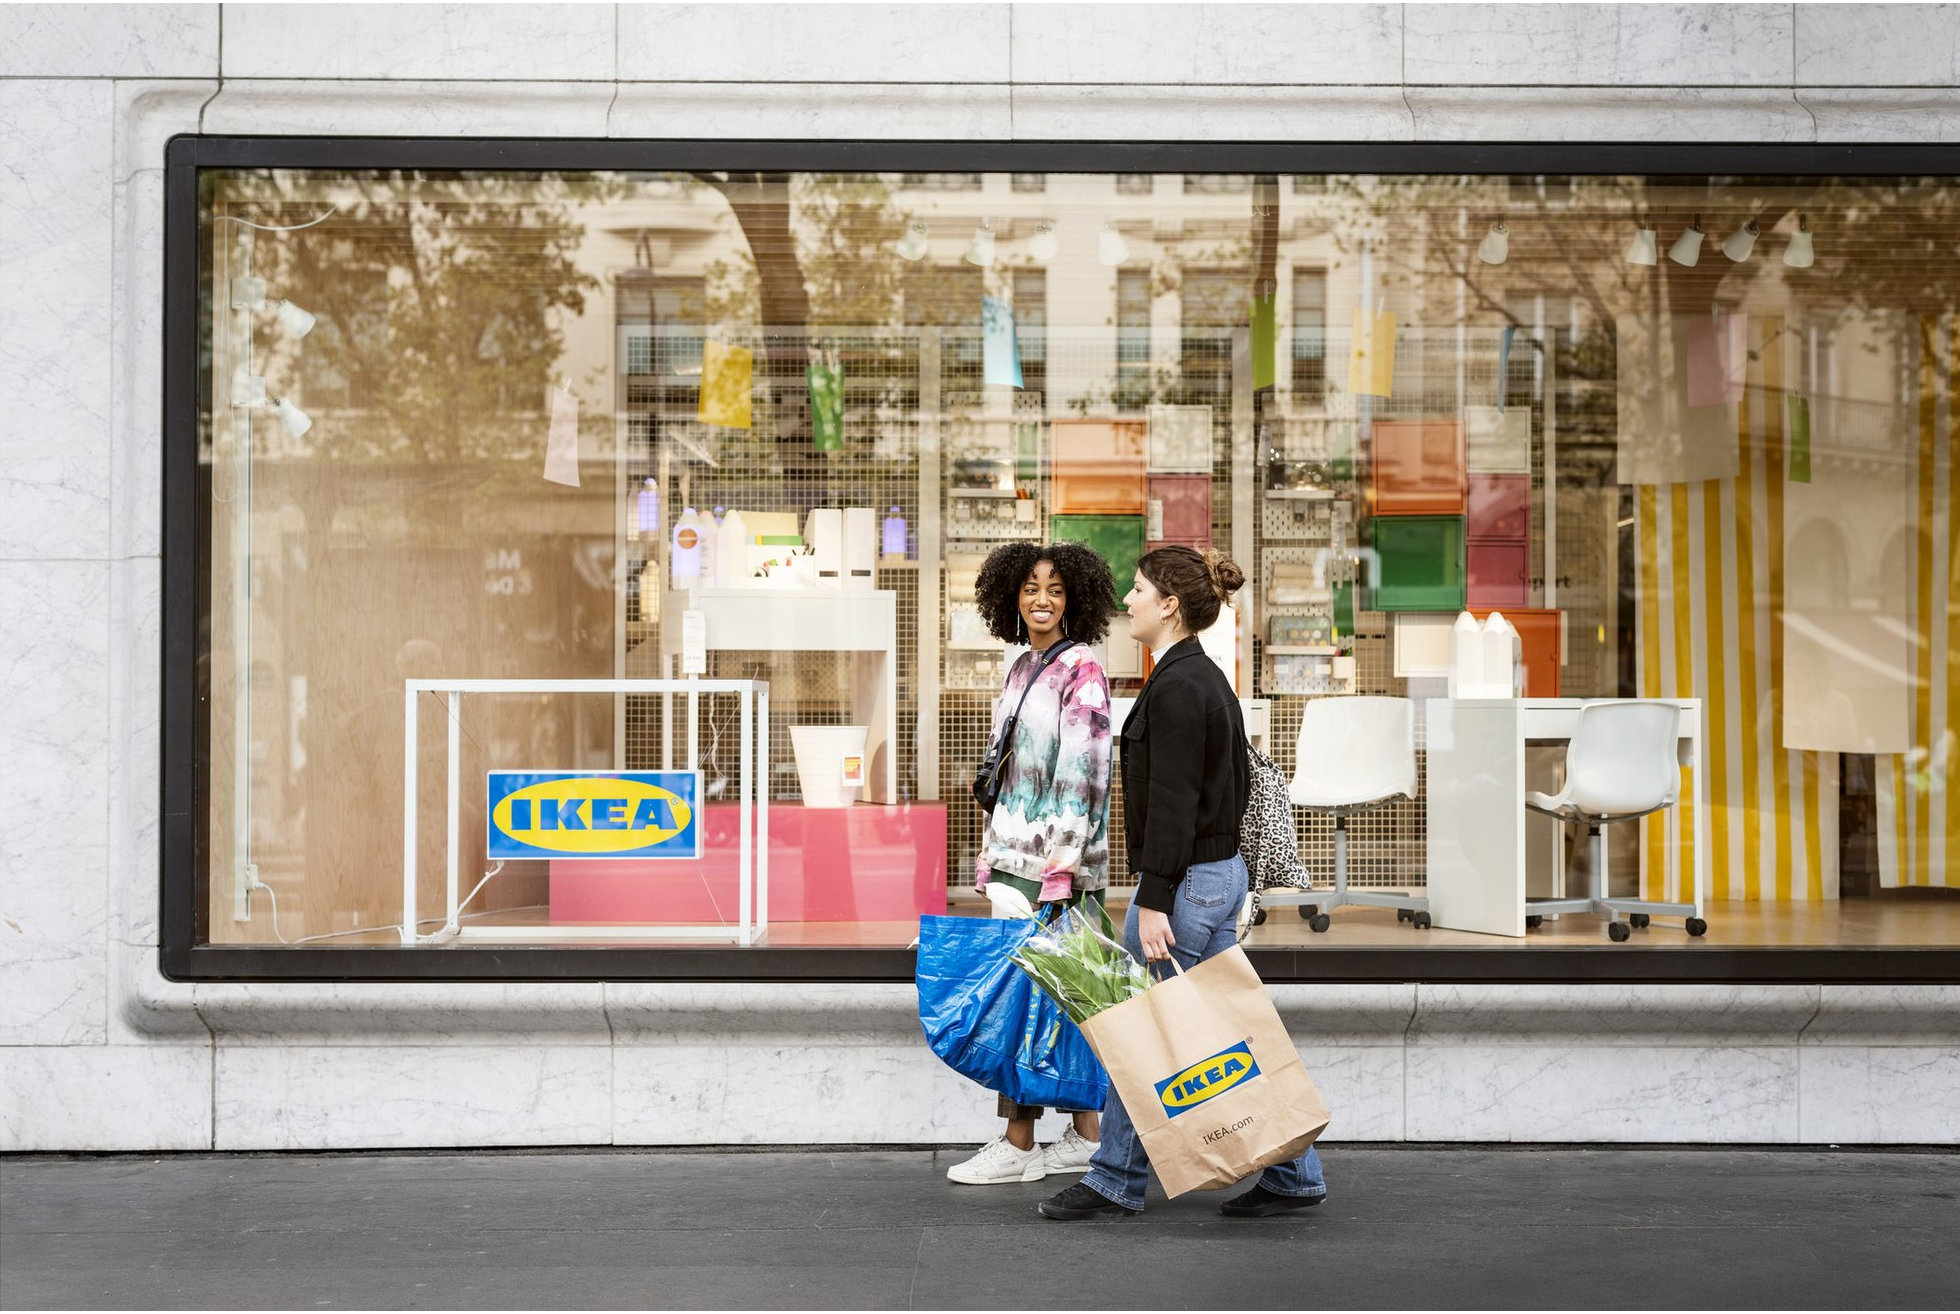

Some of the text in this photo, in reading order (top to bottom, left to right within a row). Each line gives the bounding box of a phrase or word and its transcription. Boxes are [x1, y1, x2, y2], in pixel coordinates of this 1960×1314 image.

[511, 798, 679, 831] IKEA
[1171, 1057, 1245, 1102] IKEA
[1202, 1115, 1255, 1146] IKEA.com
